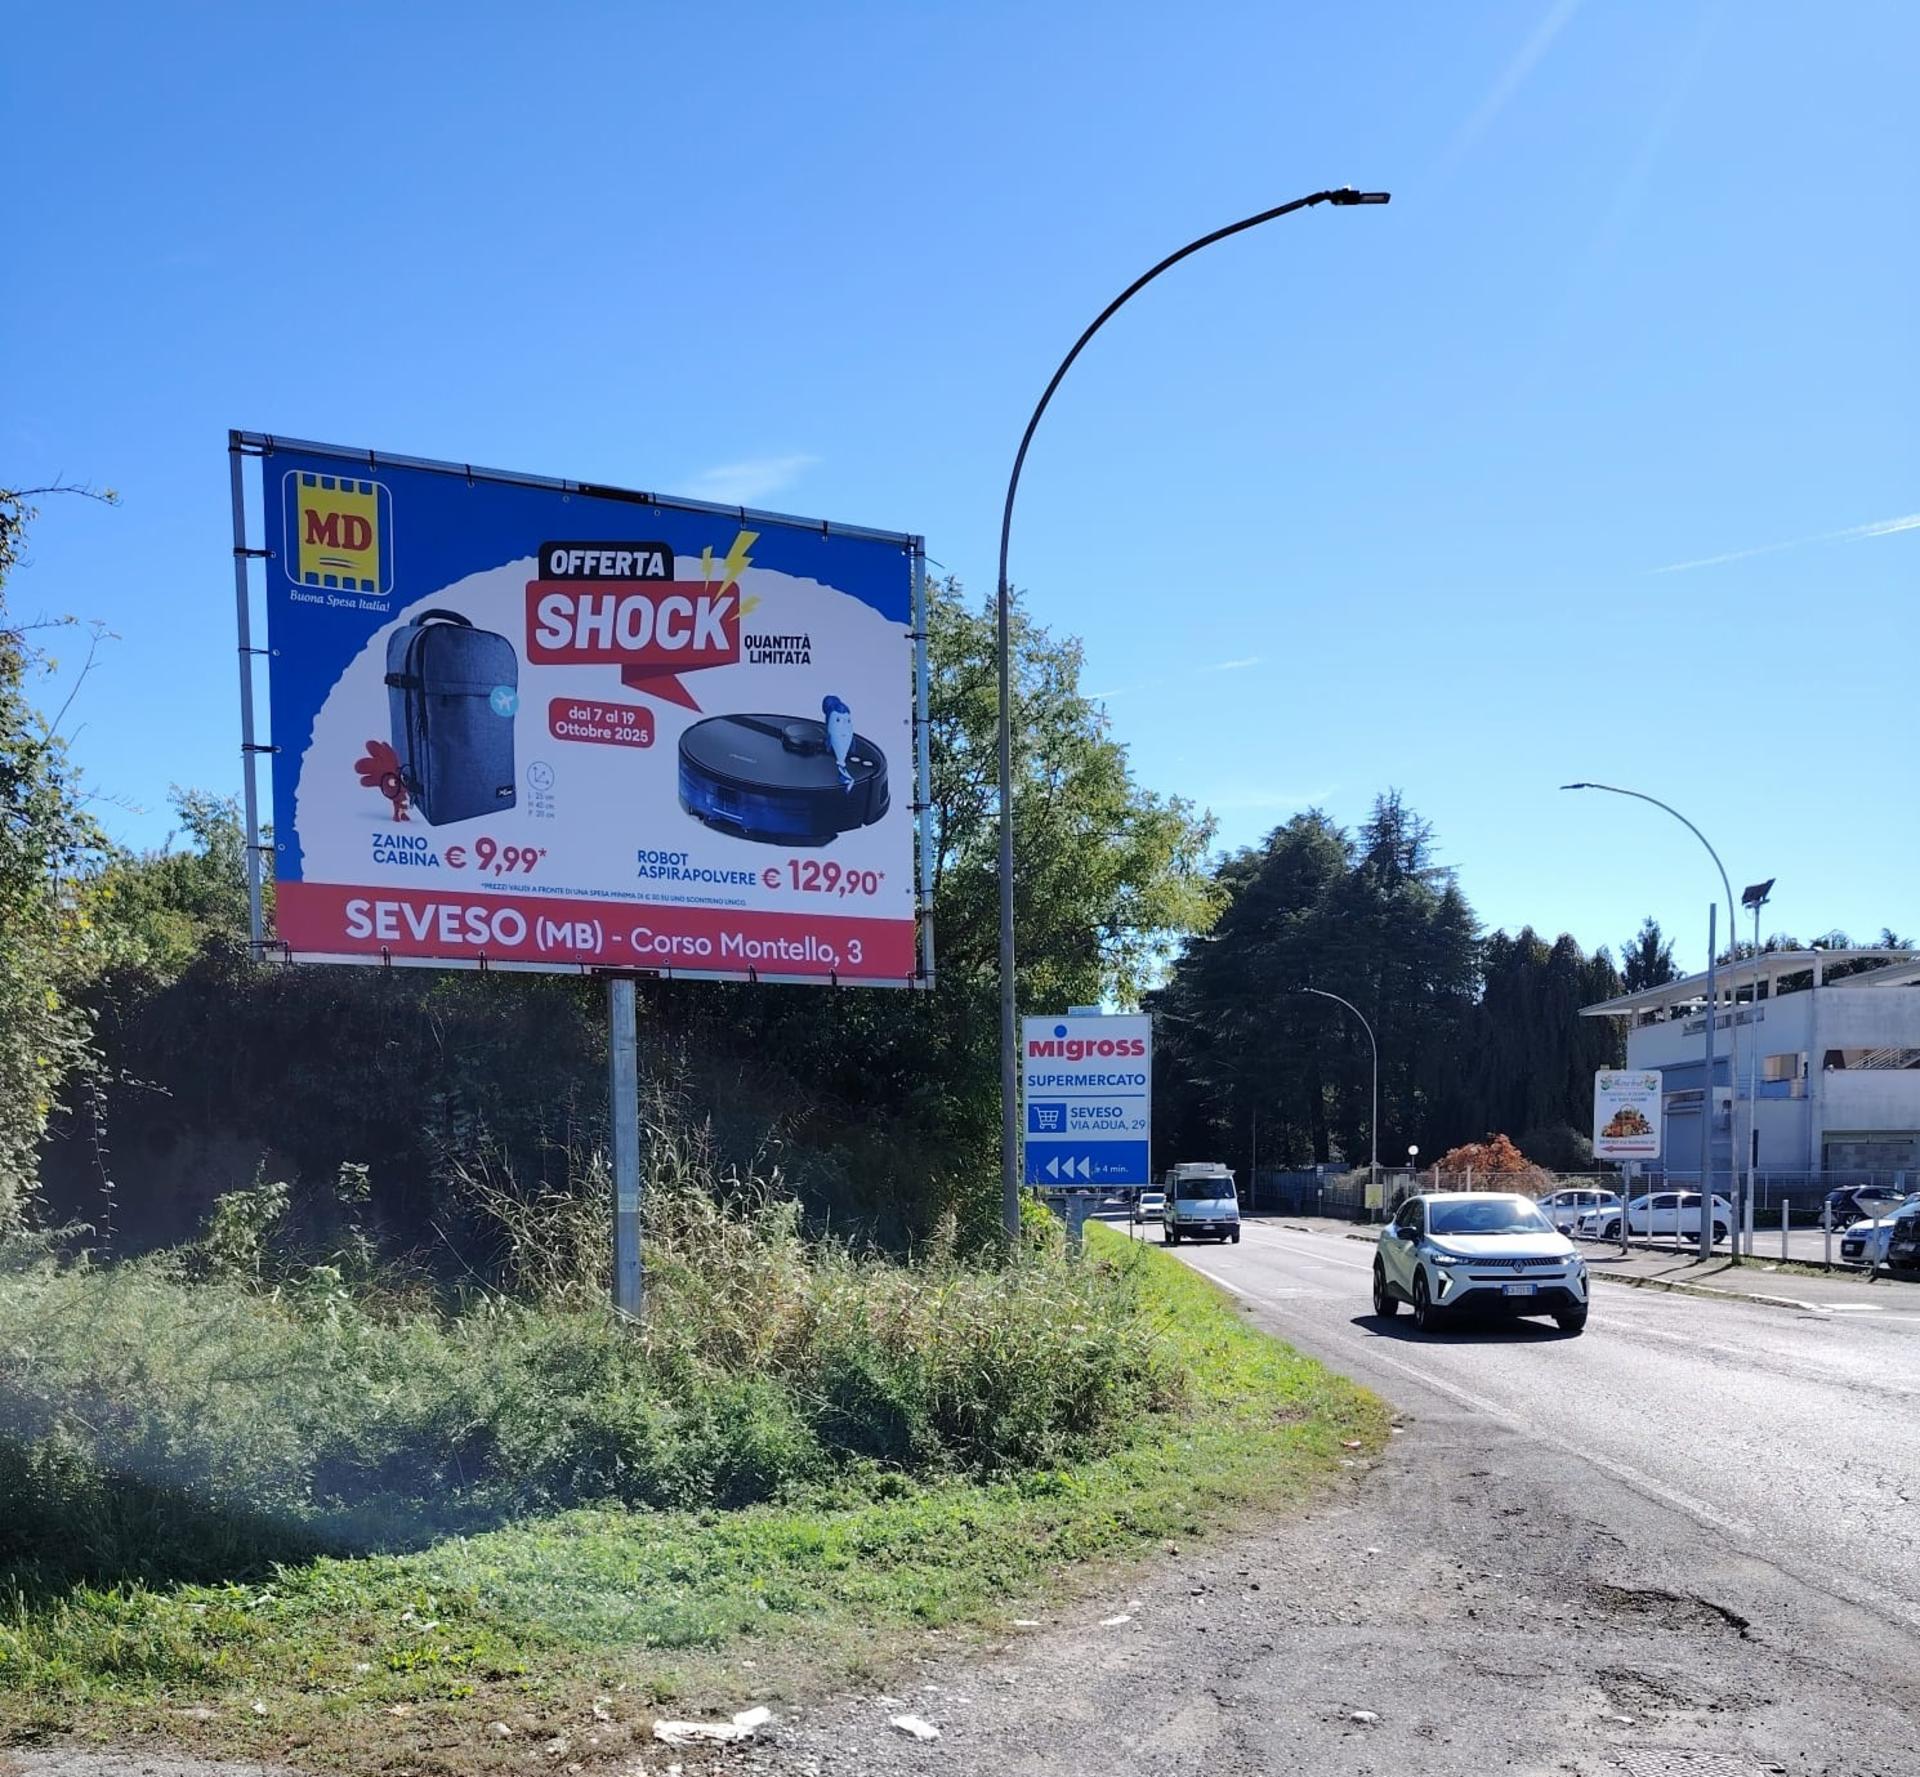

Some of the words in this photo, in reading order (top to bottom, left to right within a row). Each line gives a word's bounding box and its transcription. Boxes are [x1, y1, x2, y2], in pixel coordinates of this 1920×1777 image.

[305, 509, 372, 551] MD
[550, 549, 665, 577] OFFERTA
[290, 589, 324, 604] Buona
[326, 594, 357, 607] Spesa
[359, 598, 390, 612] Italia!
[535, 593, 735, 650] SHOCK
[744, 633, 811, 650] QUANTITÀ
[749, 651, 811, 664] LIMITATA
[569, 706, 591, 721] dal
[593, 709, 602, 721] 7
[605, 709, 619, 723] al
[622, 711, 635, 724] 19
[555, 719, 611, 739] Ottobre
[615, 728, 648, 743] 2025
[373, 834, 428, 850] ZAINO
[373, 850, 440, 867] CABINA
[445, 846, 466, 868] €
[637, 850, 689, 866] ROBOT
[638, 865, 756, 886] ASPIRAPOLVERE
[761, 868, 781, 889] €
[539, 886, 563, 894] FRONTE
[345, 899, 527, 947] SEVESO
[535, 916, 603, 954] (MB)
[630, 928, 712, 956] Corso
[721, 933, 839, 966] Montello,
[847, 939, 862, 964] 3
[1028, 1074, 1146, 1087] SUPERMERCATO
[1071, 1107, 1123, 1118] SEVESO
[1071, 1120, 1090, 1130] VIA
[1092, 1120, 1128, 1131] ADUA,
[1132, 1119, 1146, 1130] 29
[1102, 1164, 1108, 1173] 4
[1110, 1163, 1129, 1173] min.
